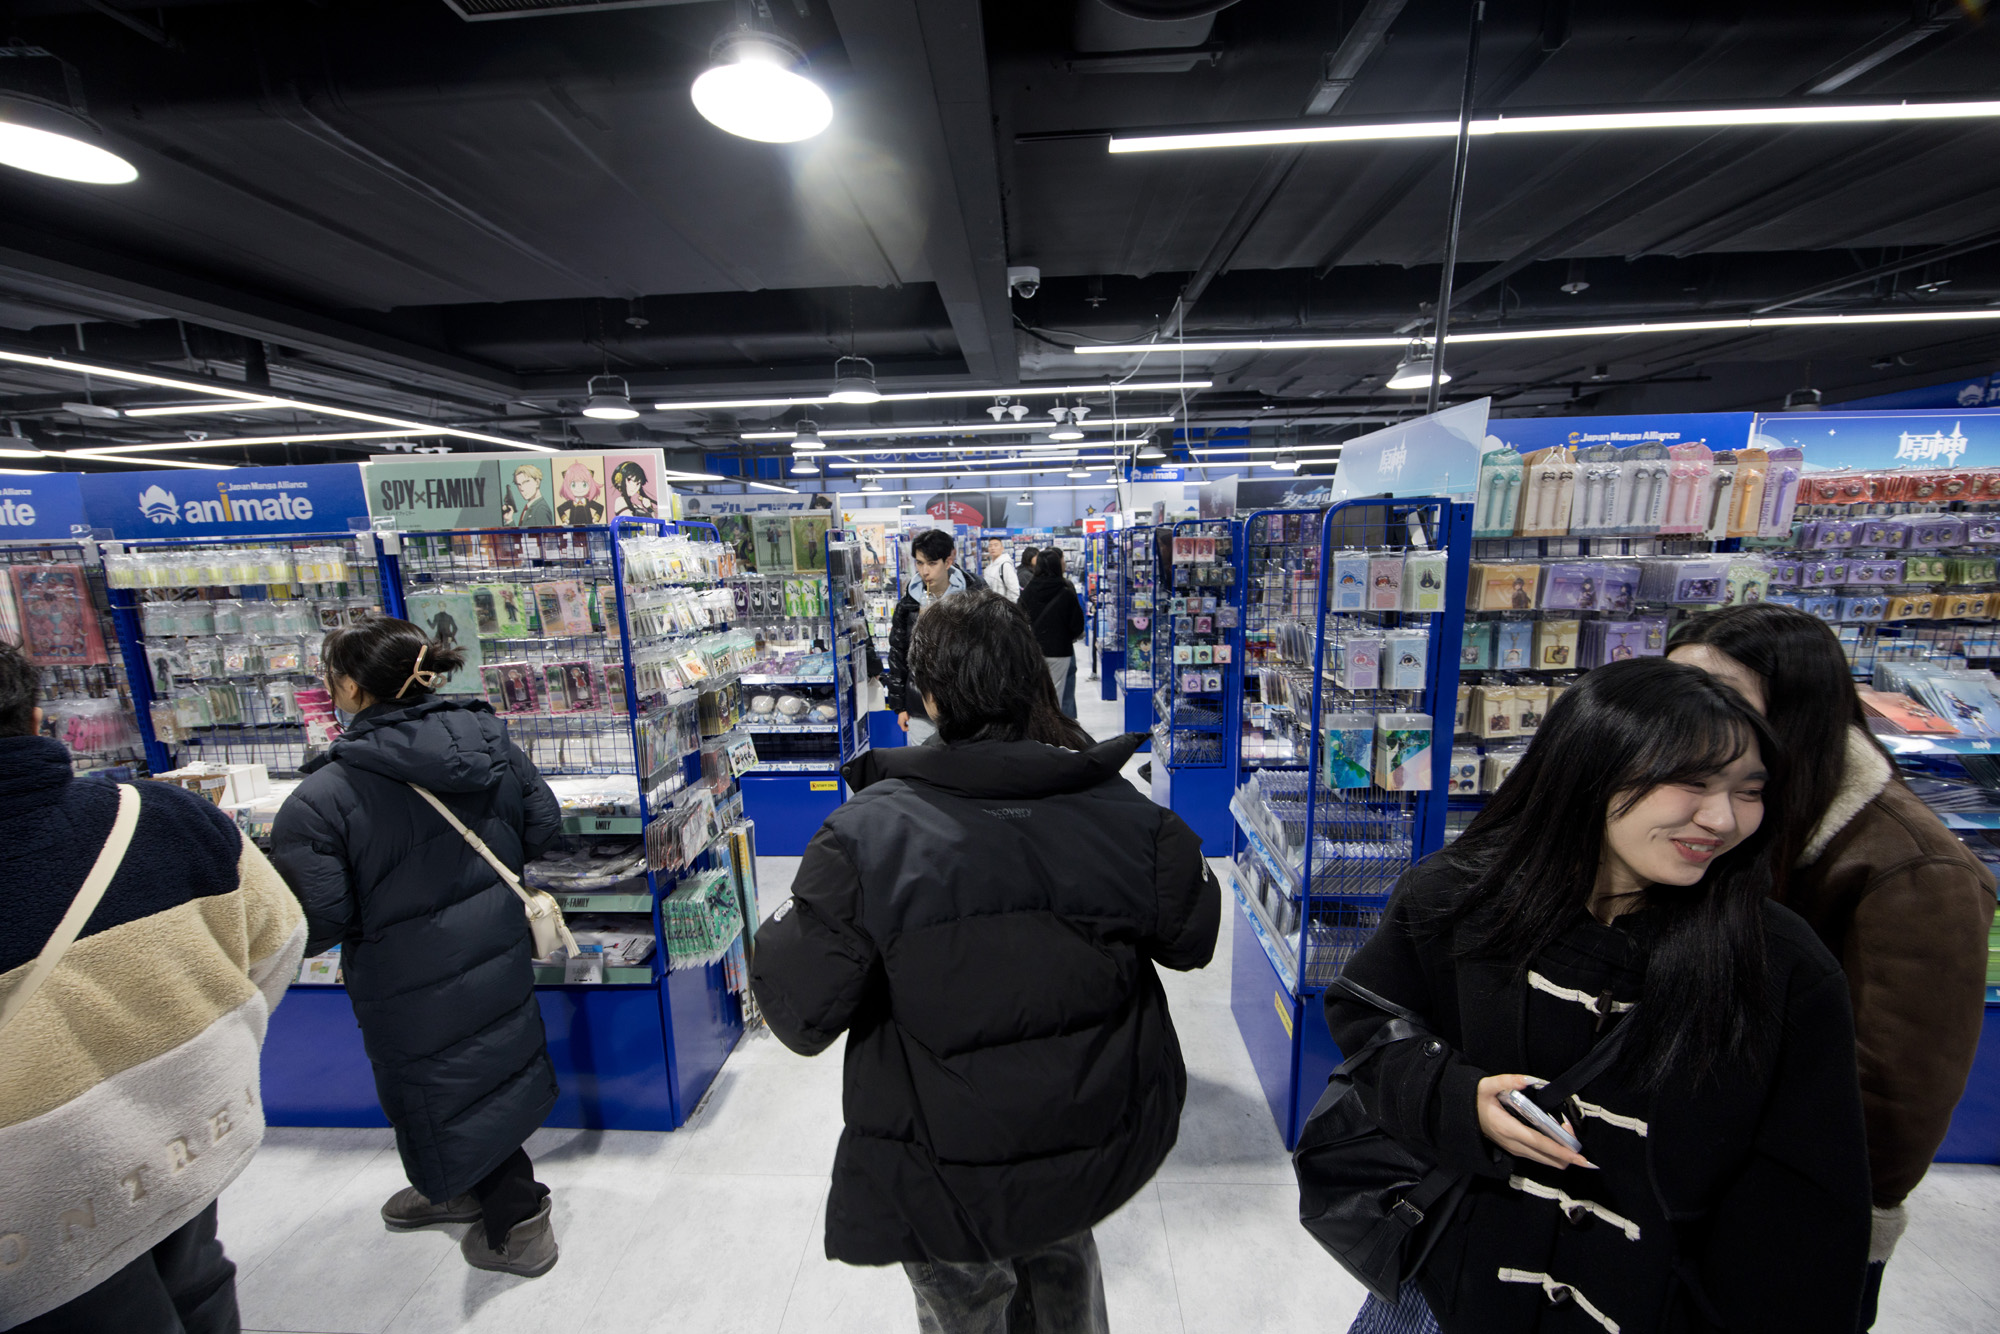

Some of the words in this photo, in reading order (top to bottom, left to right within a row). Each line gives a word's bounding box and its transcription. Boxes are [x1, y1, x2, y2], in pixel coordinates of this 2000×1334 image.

[1580, 432, 1610, 443] Japan
[1610, 431, 1642, 441] Manga
[1642, 430, 1681, 440] Alliance
[1894, 421, 1968, 468] 原神
[1142, 471, 1178, 480] animate
[228, 482, 251, 491] Japan
[251, 481, 277, 490] Manga
[277, 480, 308, 489] Alliance
[183, 492, 313, 524] animate
